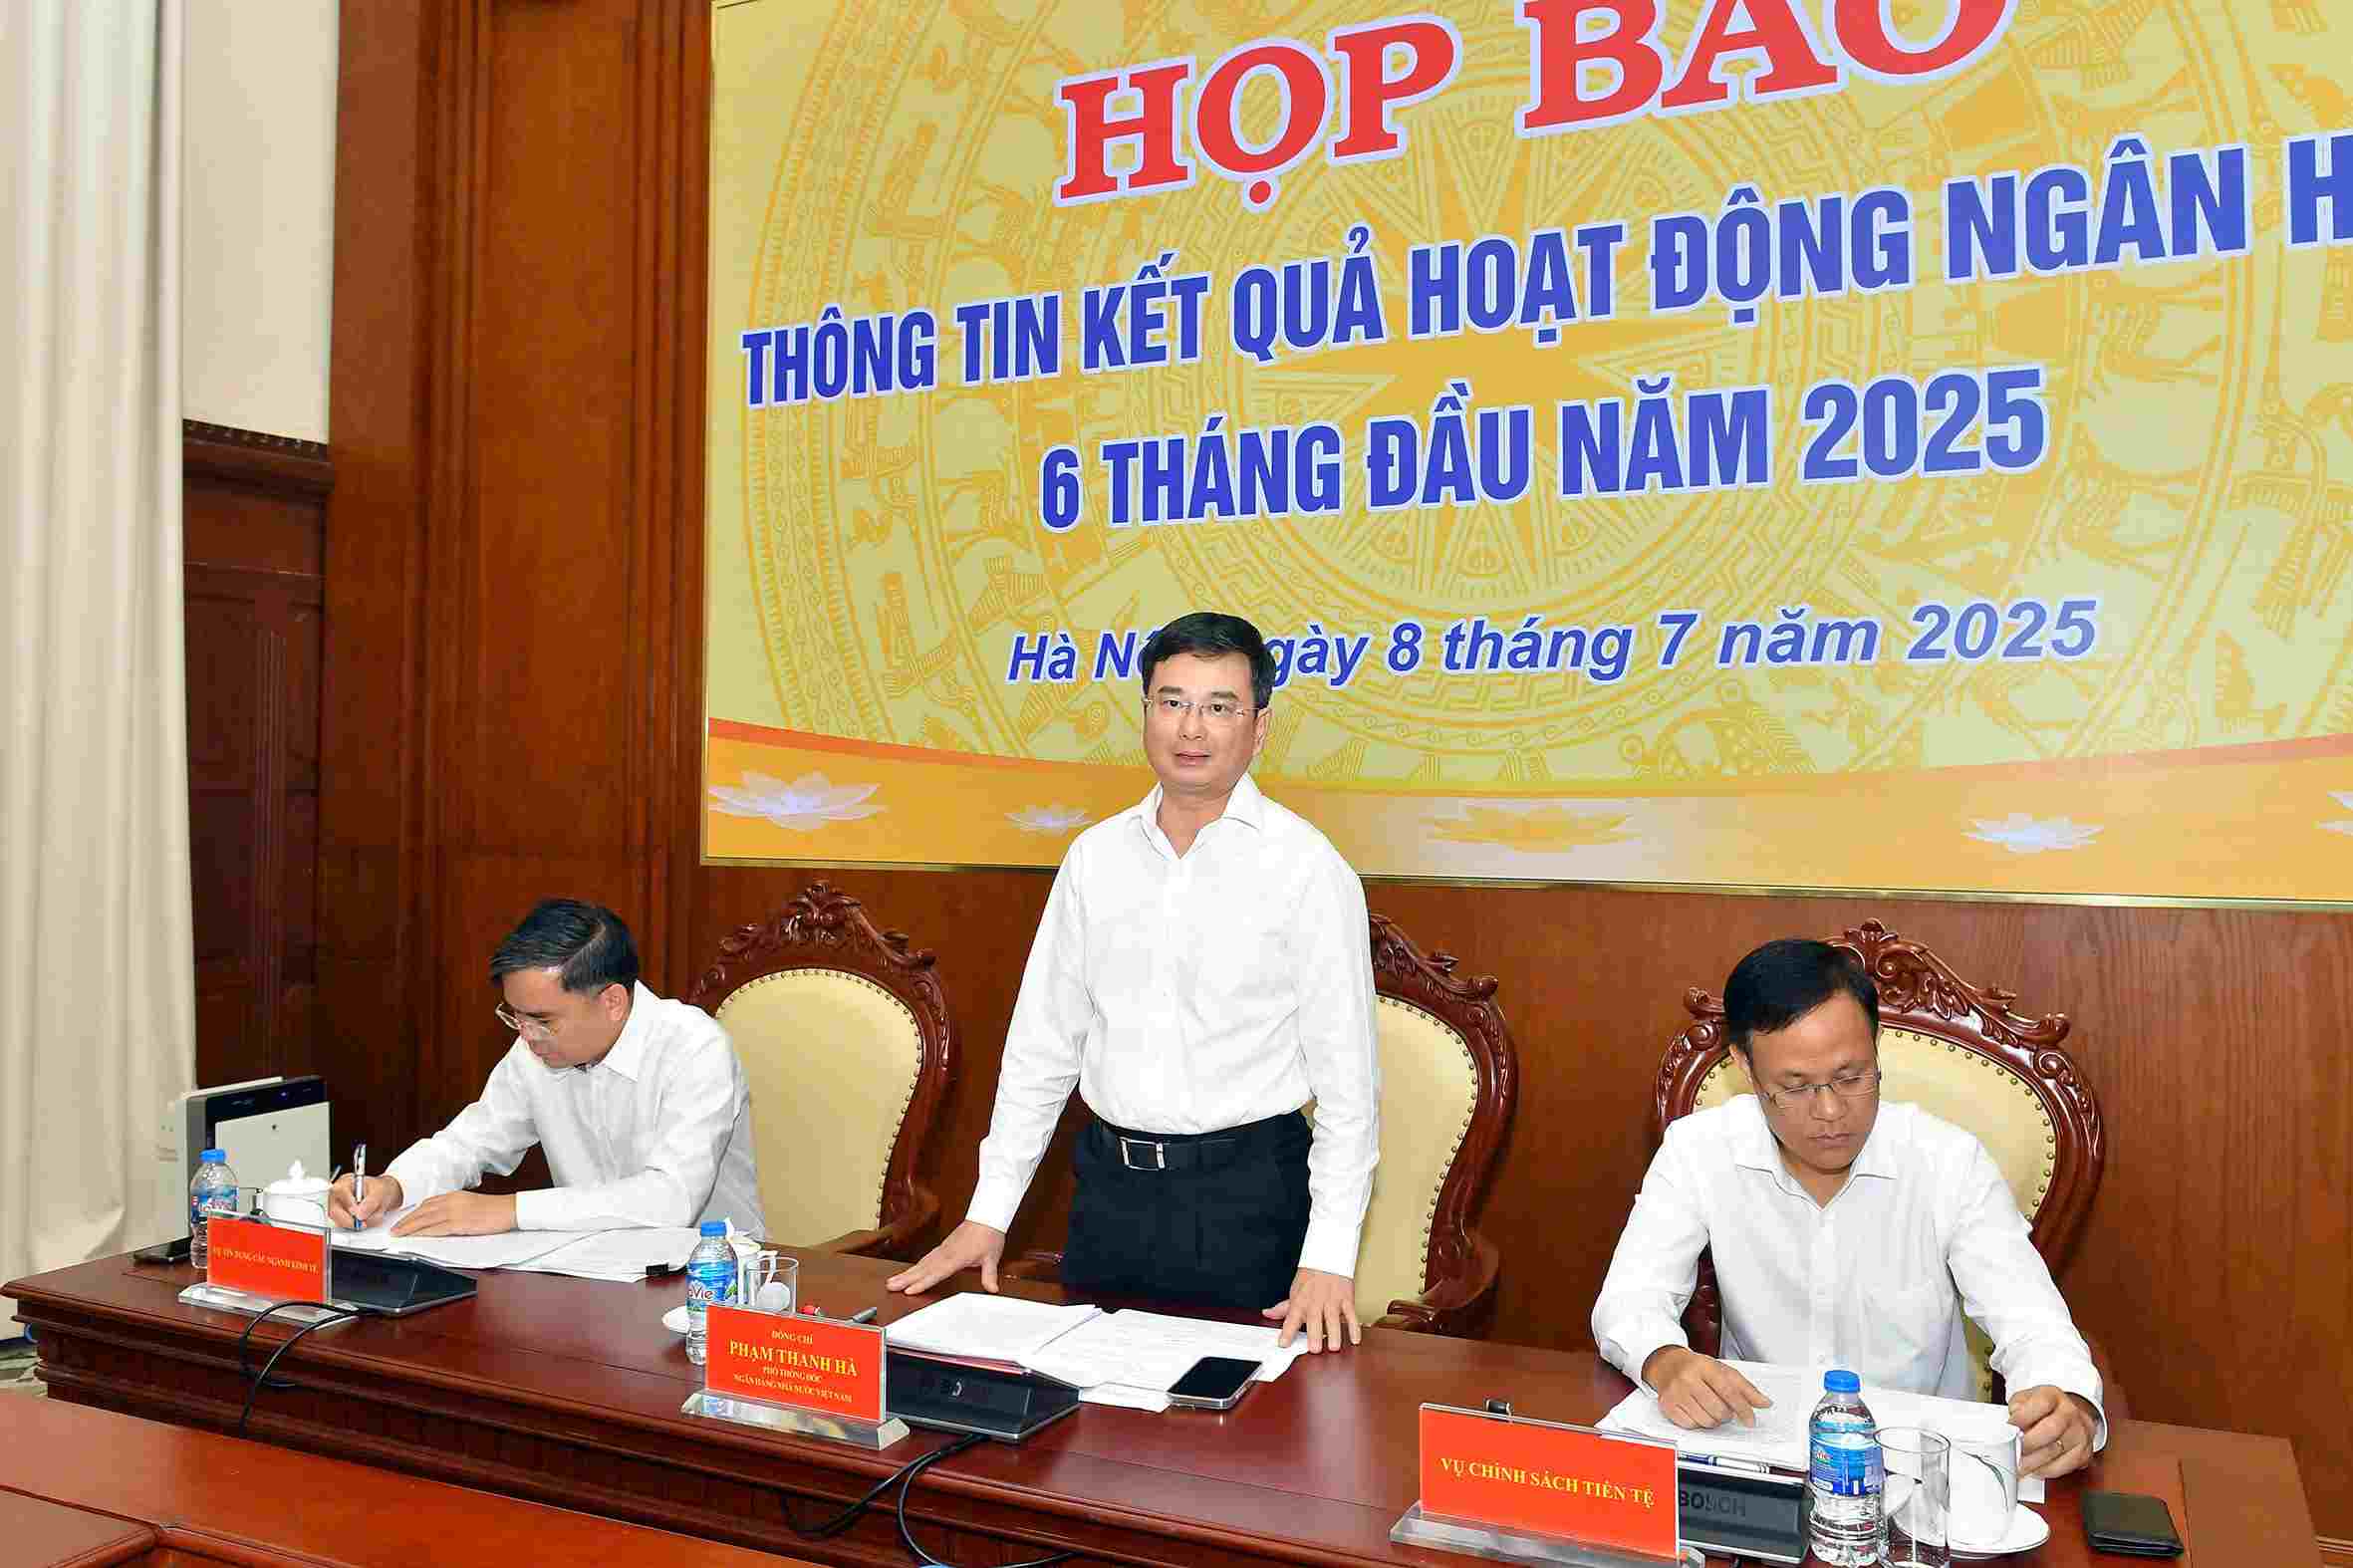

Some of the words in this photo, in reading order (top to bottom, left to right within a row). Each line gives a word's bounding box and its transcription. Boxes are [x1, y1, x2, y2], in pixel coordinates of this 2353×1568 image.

[1059, 23, 1455, 204] HỌP
[741, 305, 936, 405] THÔNG
[955, 293, 1060, 384] TIN
[1082, 251, 1210, 372] KẾT
[1232, 224, 1386, 364] QUẢ
[1410, 214, 1625, 345] HOẠT
[1649, 185, 1911, 326] ĐỘNG
[1946, 136, 2248, 281] NGÂN
[1041, 447, 1081, 530] 6
[1101, 414, 1342, 524] THÁNG
[1365, 381, 1532, 513] ĐẦU
[1560, 375, 1770, 496] NĂM
[1802, 367, 2046, 482] 2025
[1007, 633, 1078, 682] Hà
[1259, 623, 1371, 688] gày
[1386, 621, 1424, 673] 8
[1441, 615, 1634, 682] tháng
[1658, 612, 1699, 666] 7
[1717, 607, 1880, 665] năm
[1907, 599, 2098, 660] 2025
[729, 1339, 773, 1363] PHẠM
[776, 1349, 831, 1372] THANH
[835, 1357, 858, 1378] HÀ
[1440, 1456, 1464, 1478] VỤ
[1468, 1461, 1527, 1485] CHÍNH
[1529, 1469, 1579, 1494] SÁCH
[1629, 1485, 1655, 1509] TỆ
